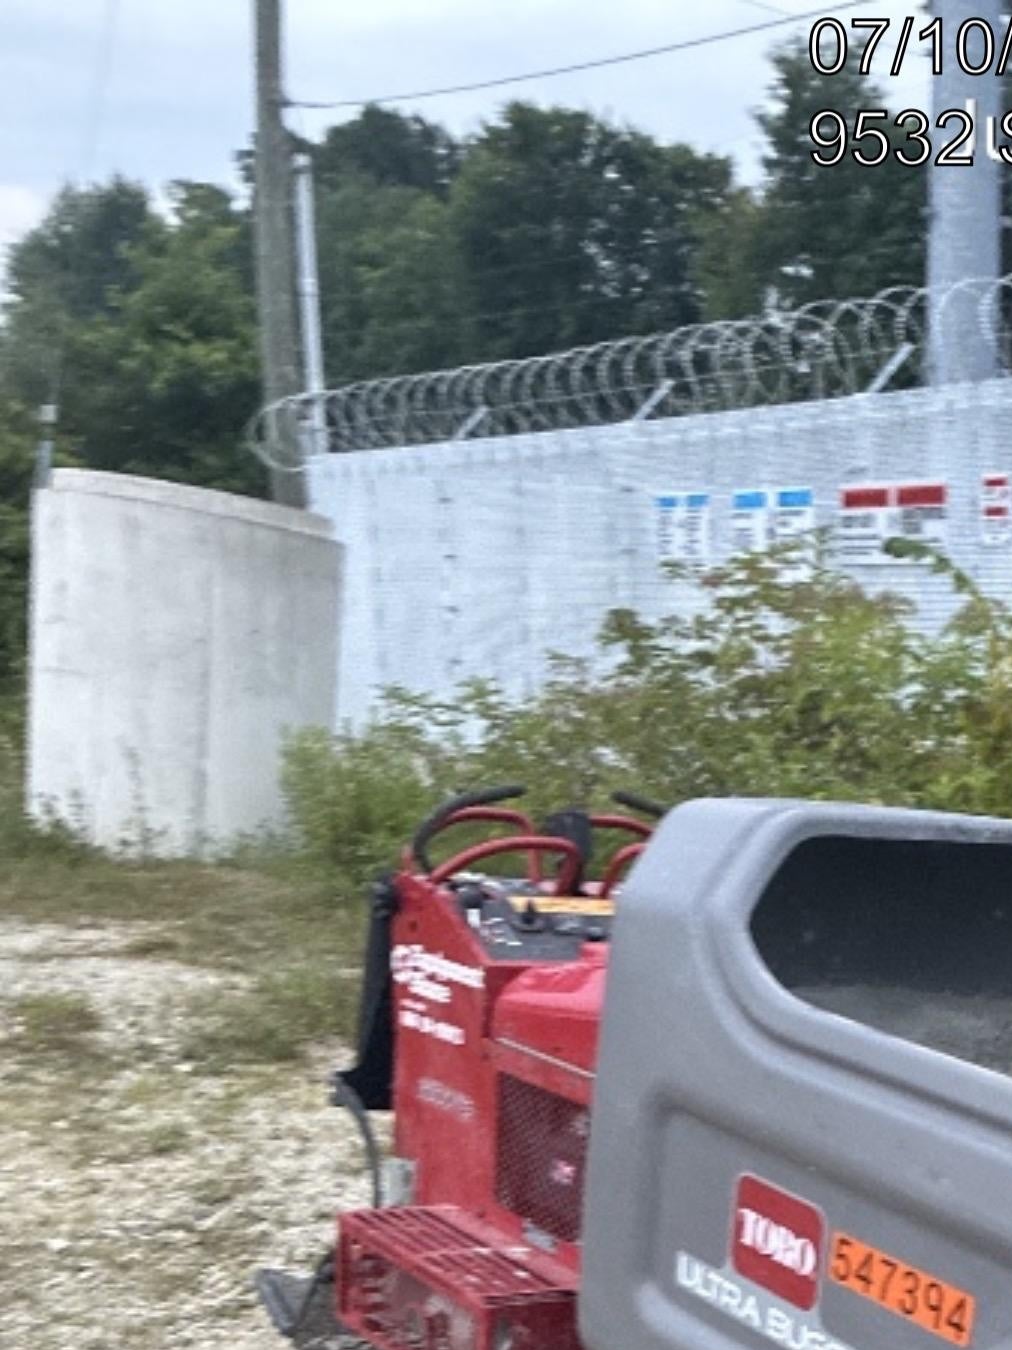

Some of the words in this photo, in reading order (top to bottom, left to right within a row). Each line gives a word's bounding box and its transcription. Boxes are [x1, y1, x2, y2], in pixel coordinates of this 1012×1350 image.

[737, 1207, 817, 1276] TORO
[676, 1252, 762, 1327] ULTRA
[830, 1236, 967, 1337] 547394
